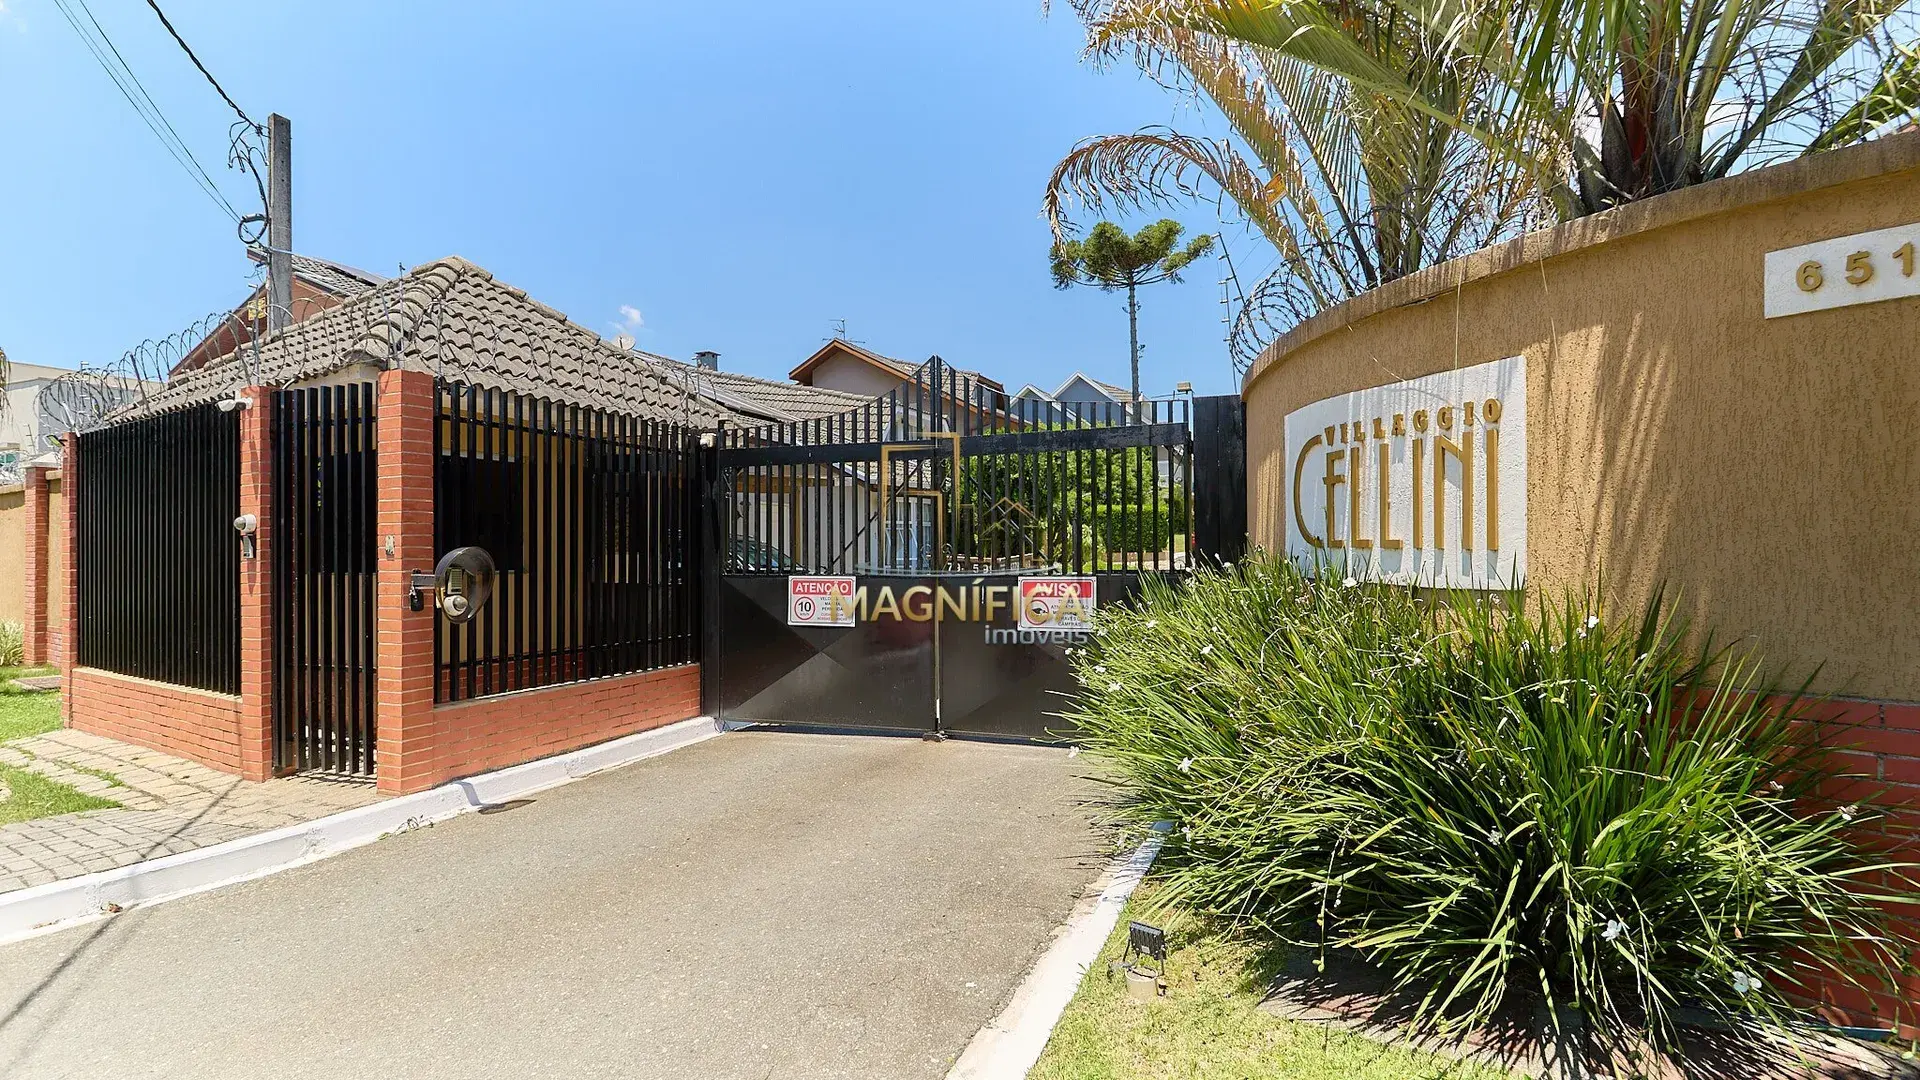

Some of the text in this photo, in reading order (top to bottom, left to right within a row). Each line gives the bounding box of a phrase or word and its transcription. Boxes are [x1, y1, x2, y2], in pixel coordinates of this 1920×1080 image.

[1796, 241, 1915, 292] 651
[1324, 398, 1502, 447] VILLAGGIO
[1293, 428, 1499, 552] CELLINI
[795, 580, 849, 596] ATENÇÃO
[1033, 582, 1082, 597] AVISO
[798, 601, 812, 612] 10
